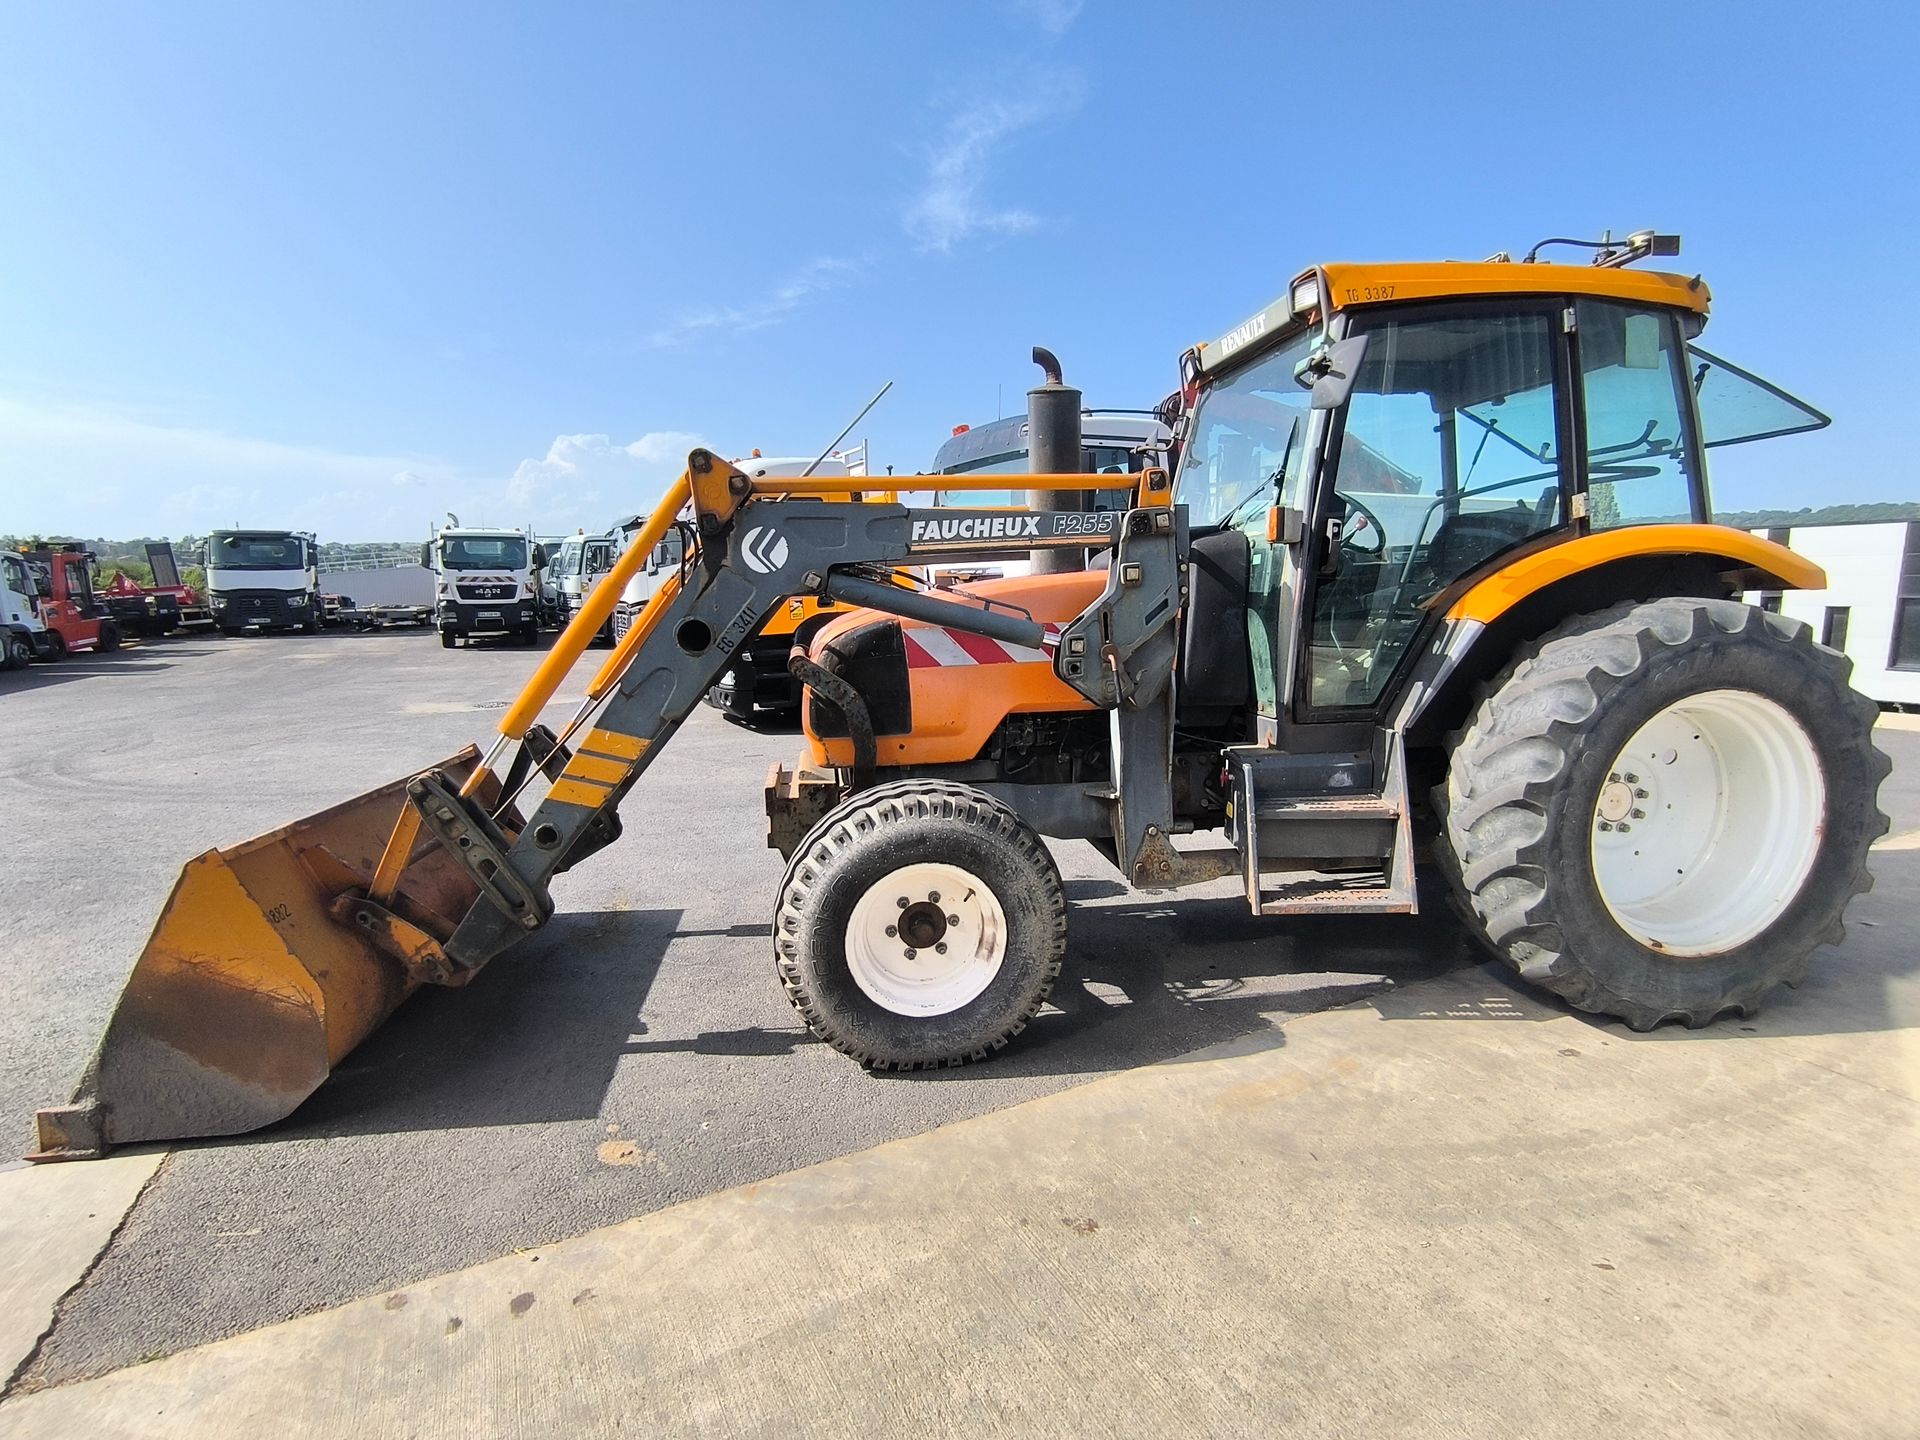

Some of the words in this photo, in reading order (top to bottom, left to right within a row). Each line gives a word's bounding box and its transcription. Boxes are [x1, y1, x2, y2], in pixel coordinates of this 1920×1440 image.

[1346, 288, 1358, 302] TG
[1365, 285, 1395, 299] 3387
[1220, 314, 1266, 357] RENAULT
[911, 516, 1041, 541] FAUCHEUX
[1052, 513, 1113, 535] F255
[716, 637, 735, 655] EG
[733, 606, 758, 634] 3411
